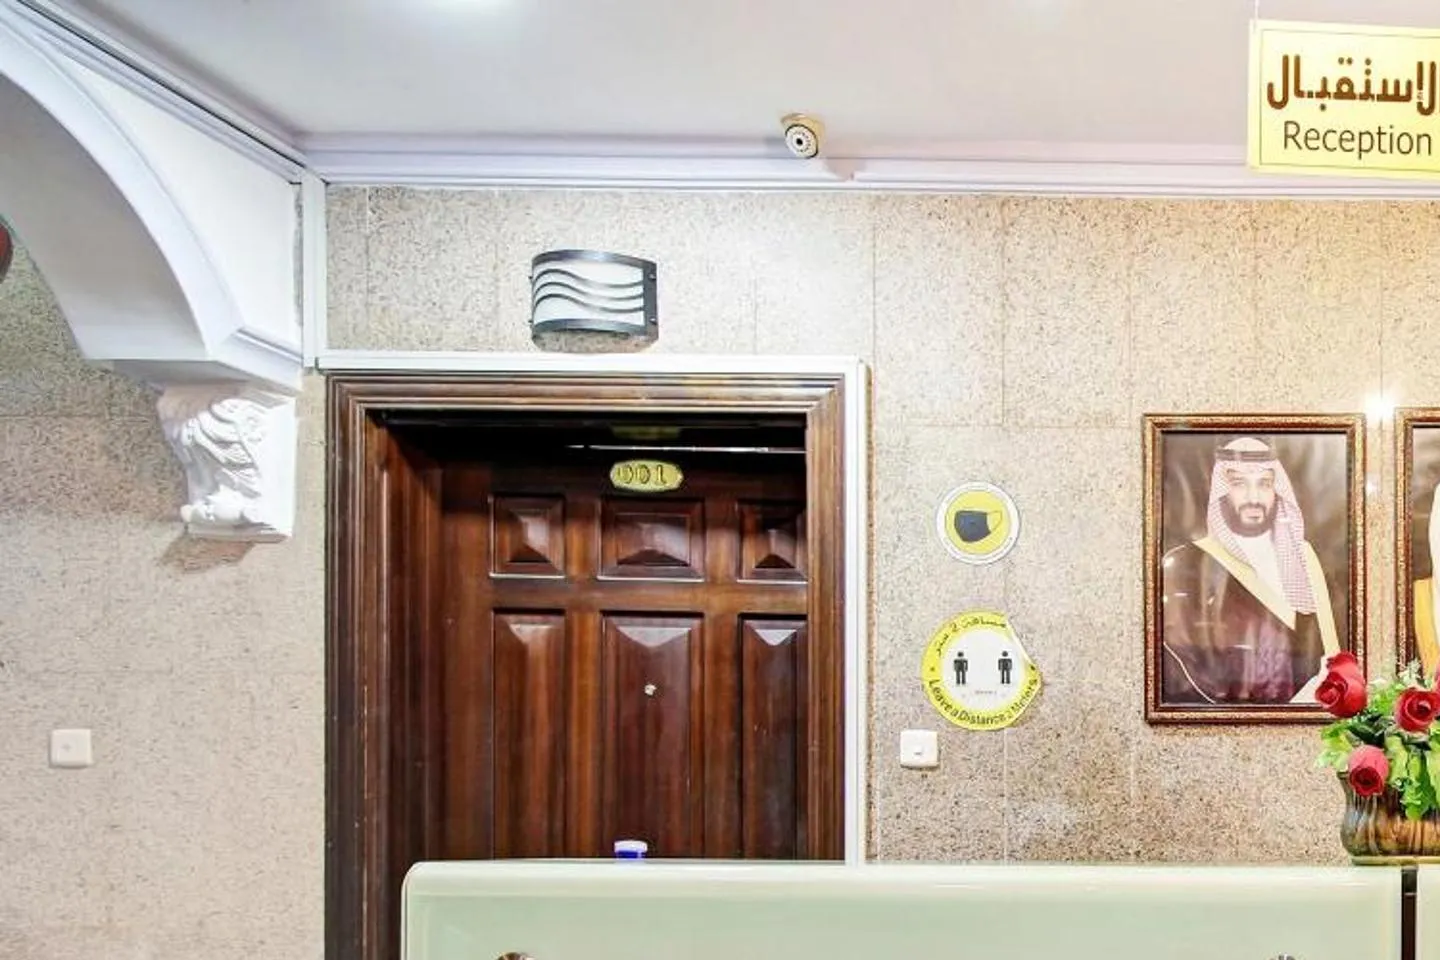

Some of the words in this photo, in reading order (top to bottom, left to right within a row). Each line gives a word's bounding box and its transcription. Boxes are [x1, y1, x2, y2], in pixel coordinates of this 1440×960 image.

[1283, 120, 1432, 159] Reception
[929, 679, 953, 711] Leave
[957, 709, 1006, 725] Distance
